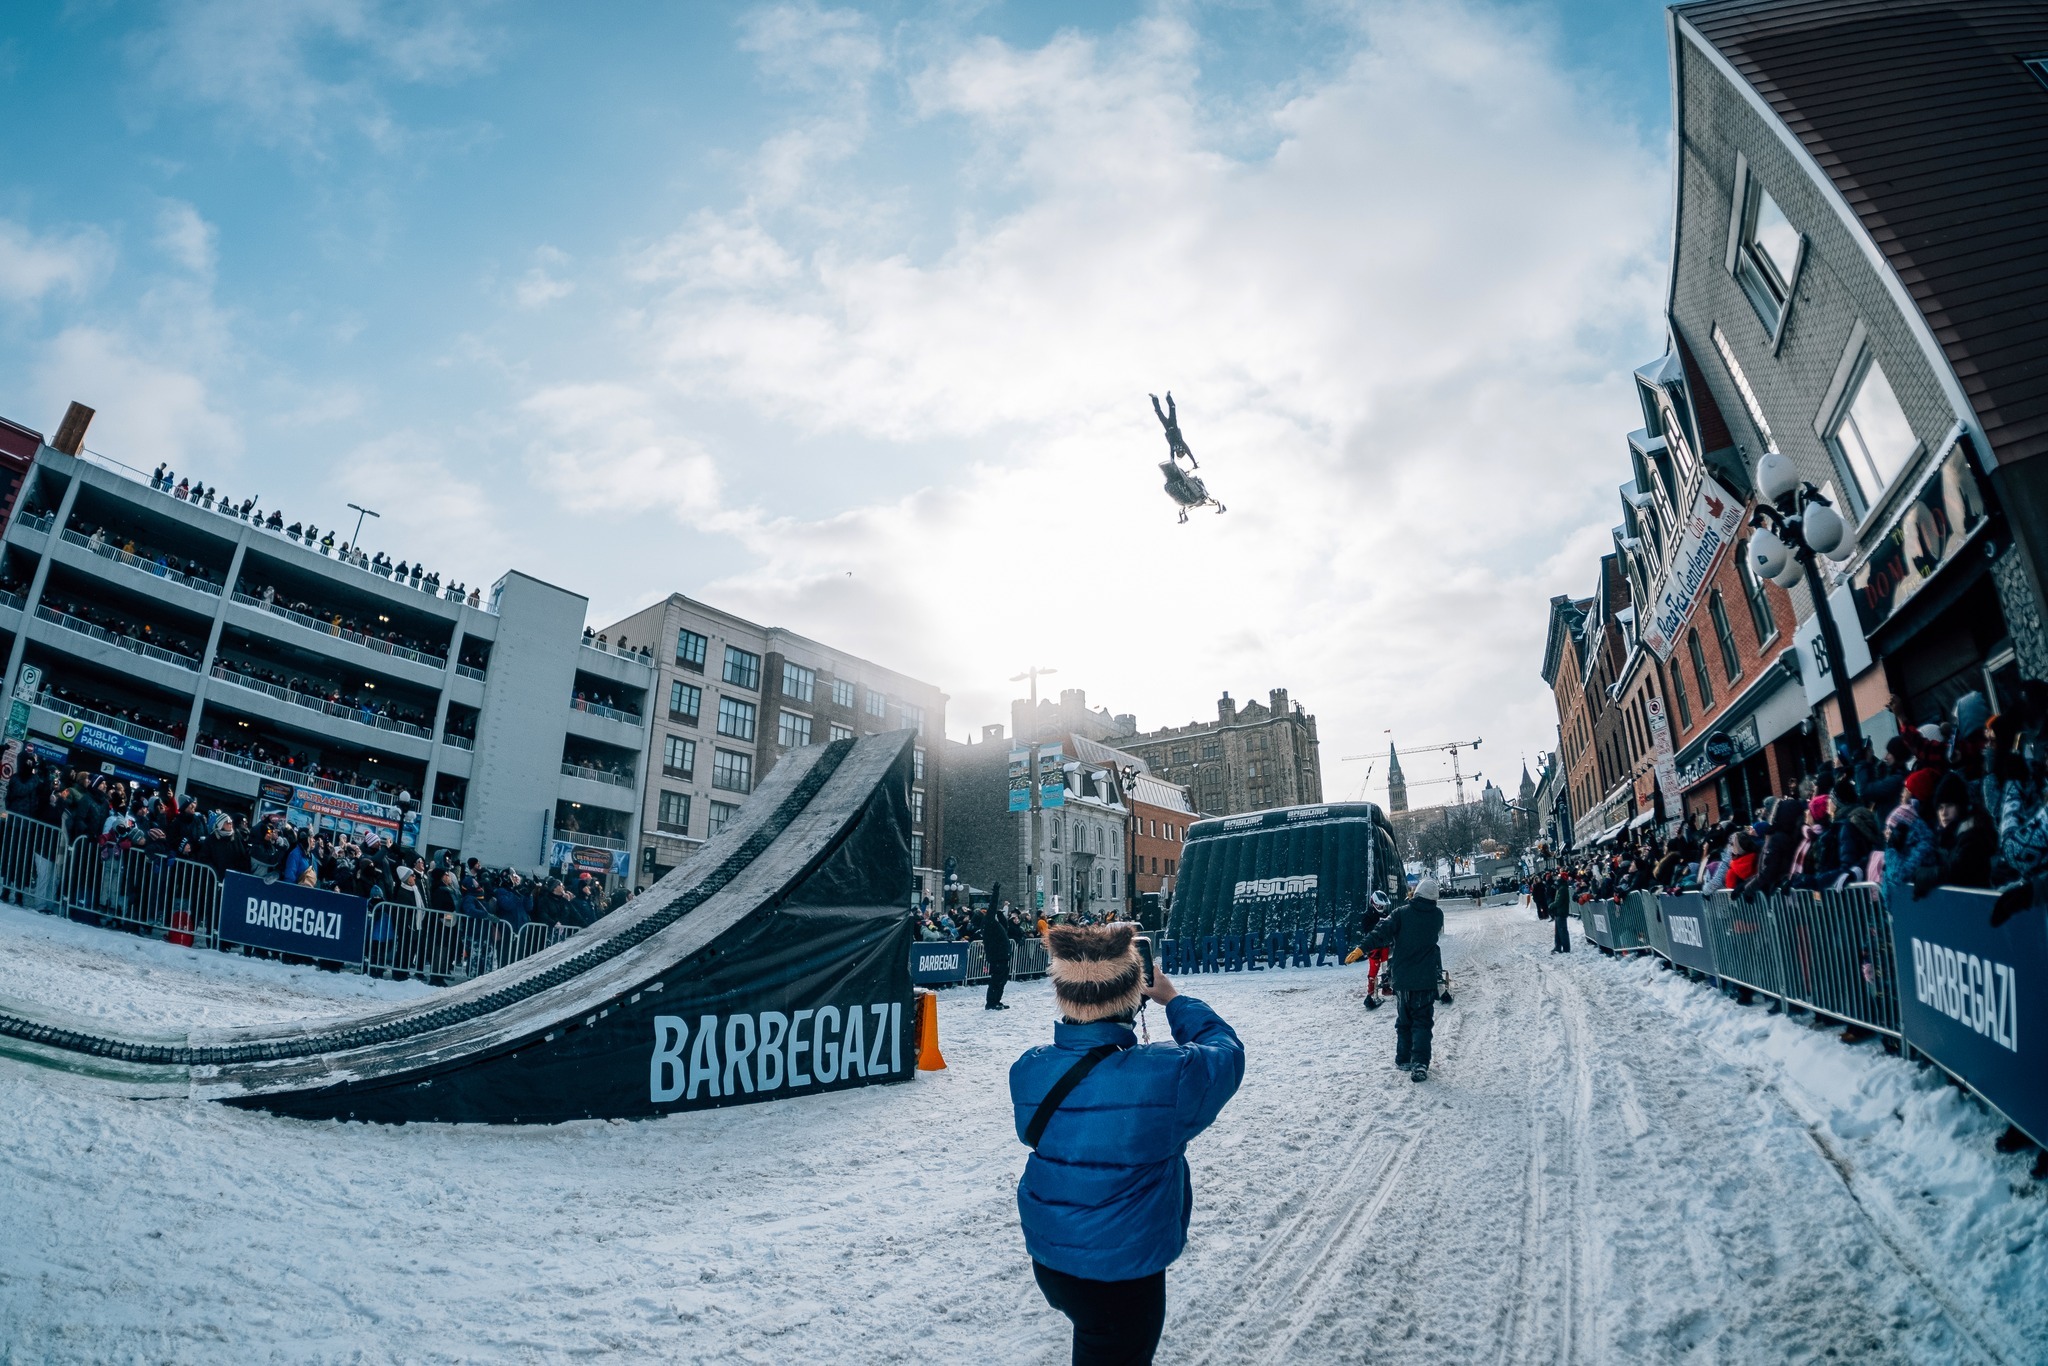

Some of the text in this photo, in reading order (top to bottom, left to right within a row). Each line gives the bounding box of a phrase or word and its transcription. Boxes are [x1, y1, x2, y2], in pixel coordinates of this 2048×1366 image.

[1688, 513, 1706, 539] Club
[1720, 505, 1742, 537] CANADIAN
[1677, 525, 1721, 599] Gentlemens
[80, 735, 124, 756] PARKING
[82, 726, 119, 744] PUBLIC
[296, 789, 359, 812] ULTRASHINE
[362, 803, 384, 817] CAR
[1233, 874, 1318, 896] BAGJUMP
[246, 897, 341, 940] BARBEGAZI
[919, 952, 959, 972] BARBEGAZI
[1161, 926, 1348, 976] BARBEGAZI
[1911, 937, 2018, 1053] BARBEGAZI
[650, 1002, 902, 1103] BARBEGAZI
